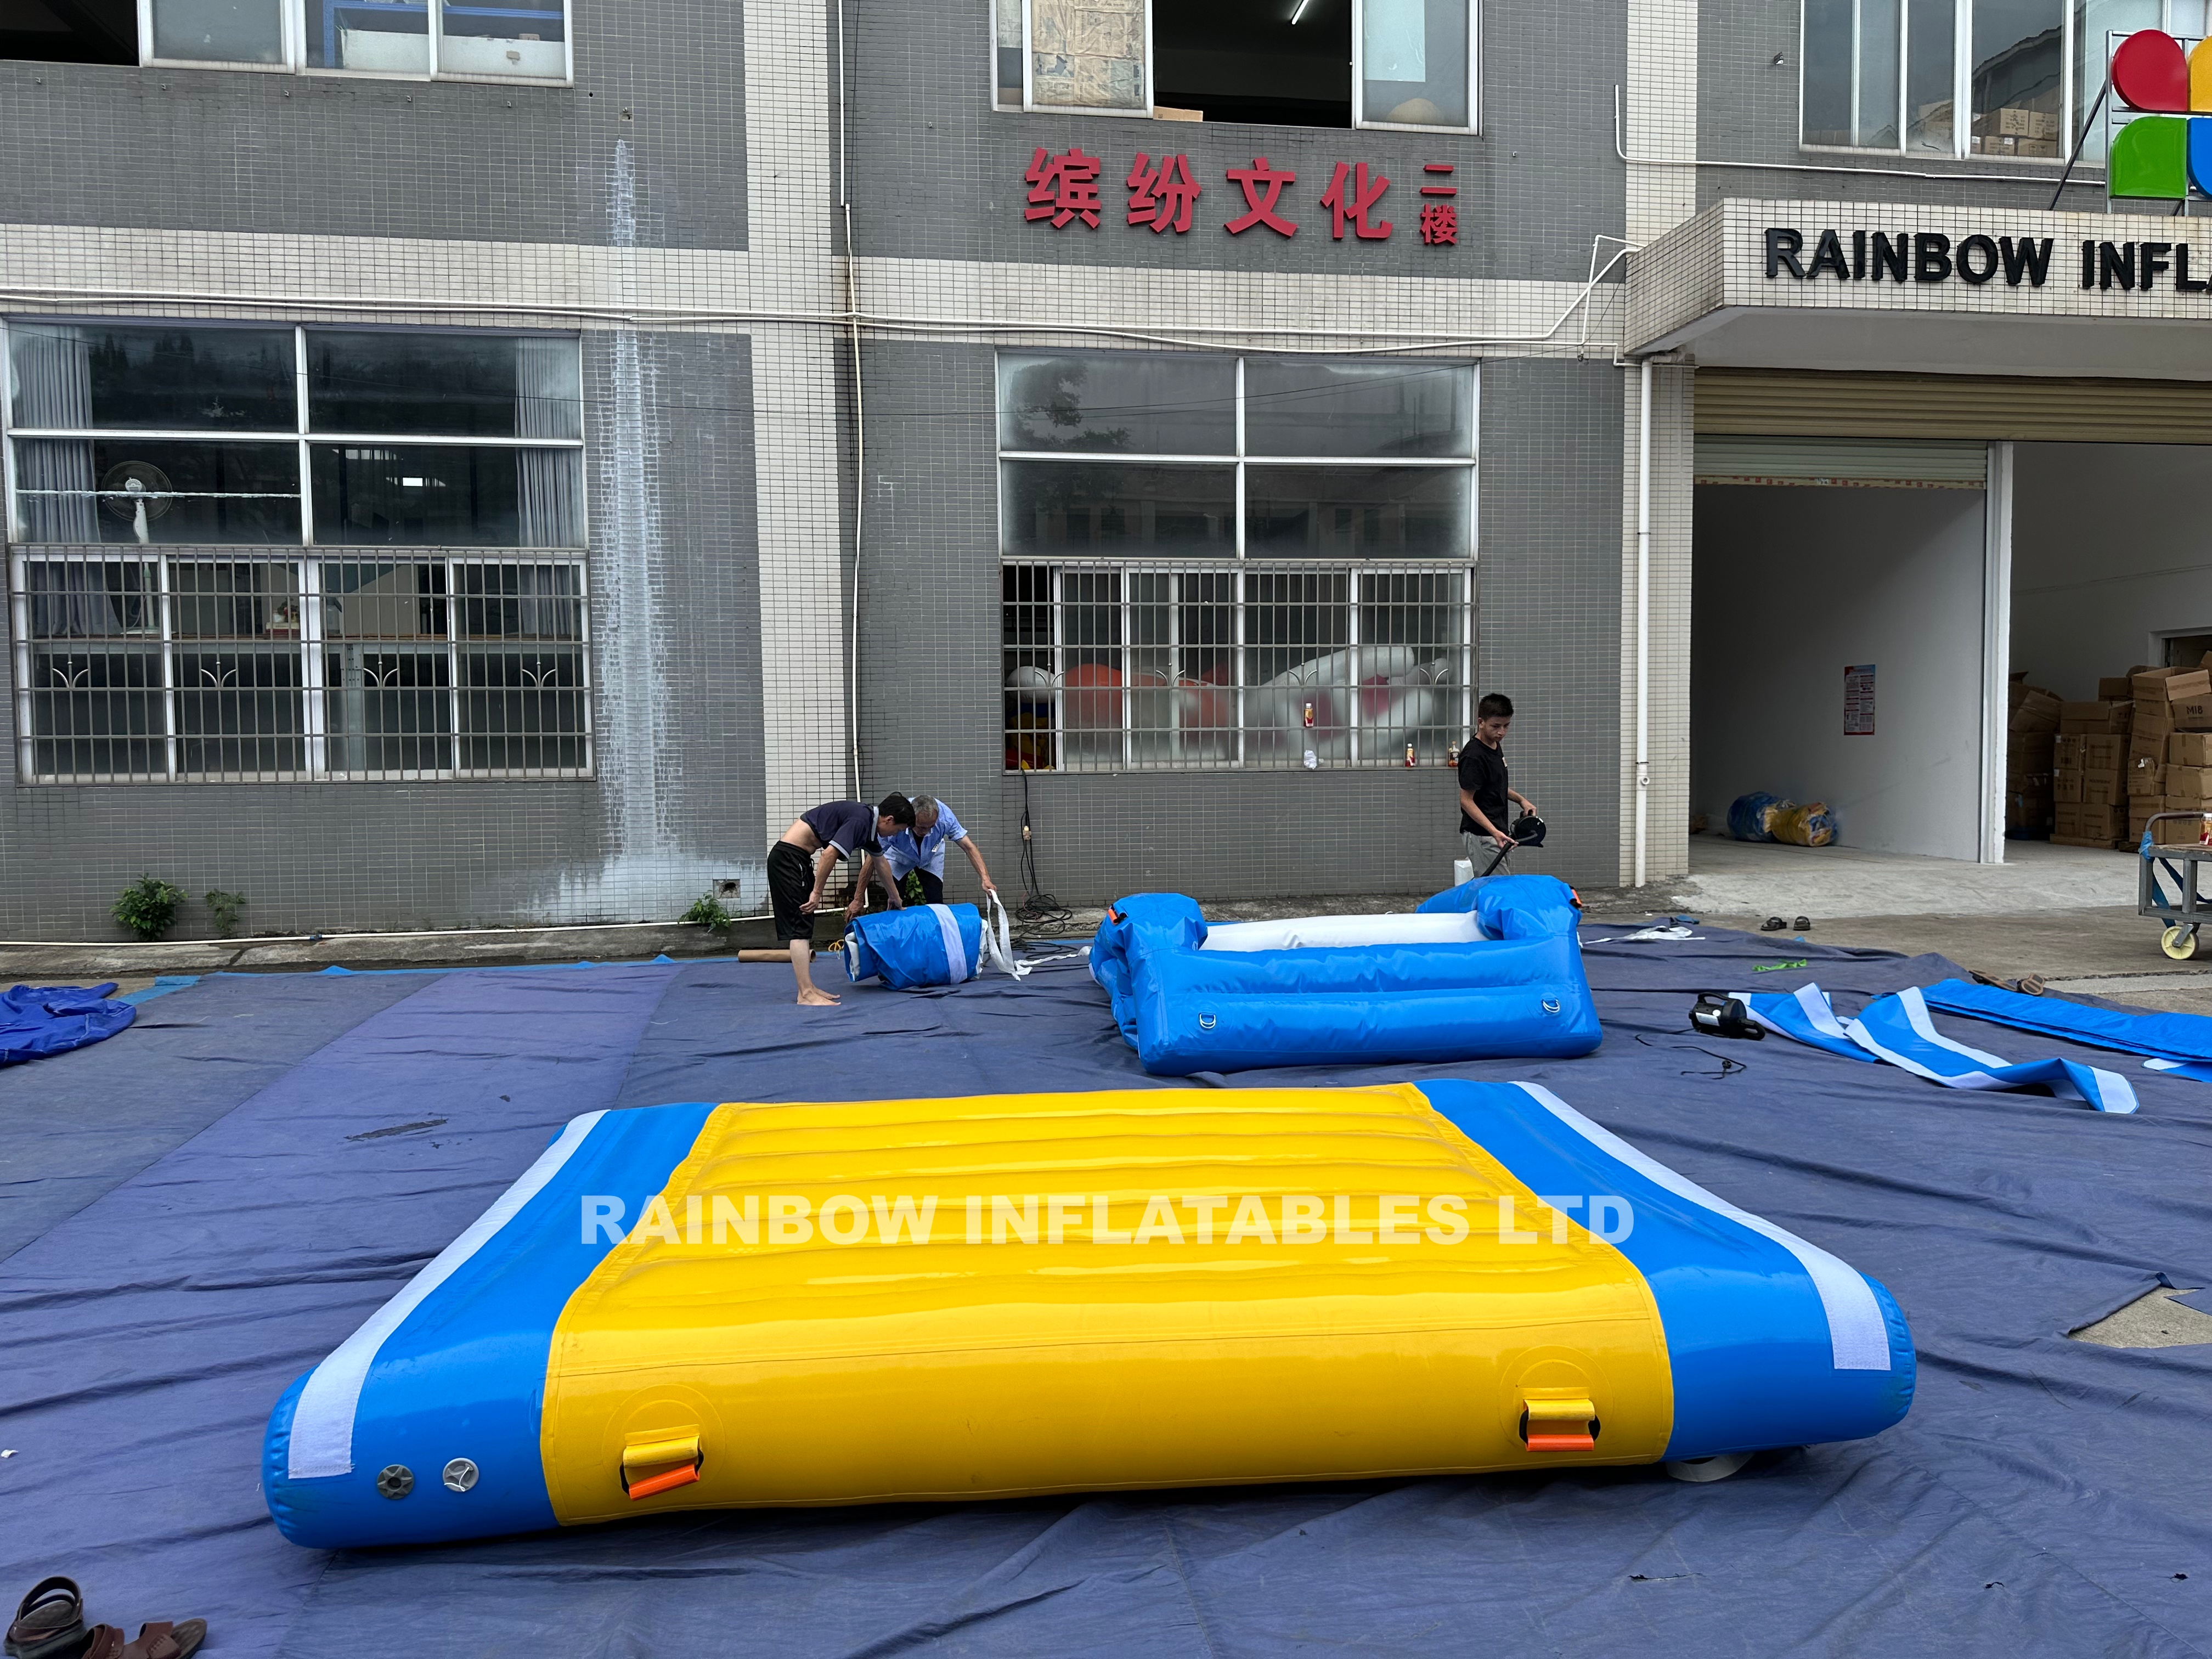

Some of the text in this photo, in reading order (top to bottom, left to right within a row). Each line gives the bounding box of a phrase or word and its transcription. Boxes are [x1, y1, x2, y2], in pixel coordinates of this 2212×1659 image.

[1024, 147, 1393, 240] 缤纷文化
[1420, 164, 1458, 245] 二楼
[1765, 228, 2212, 292] RAINBOW INFL
